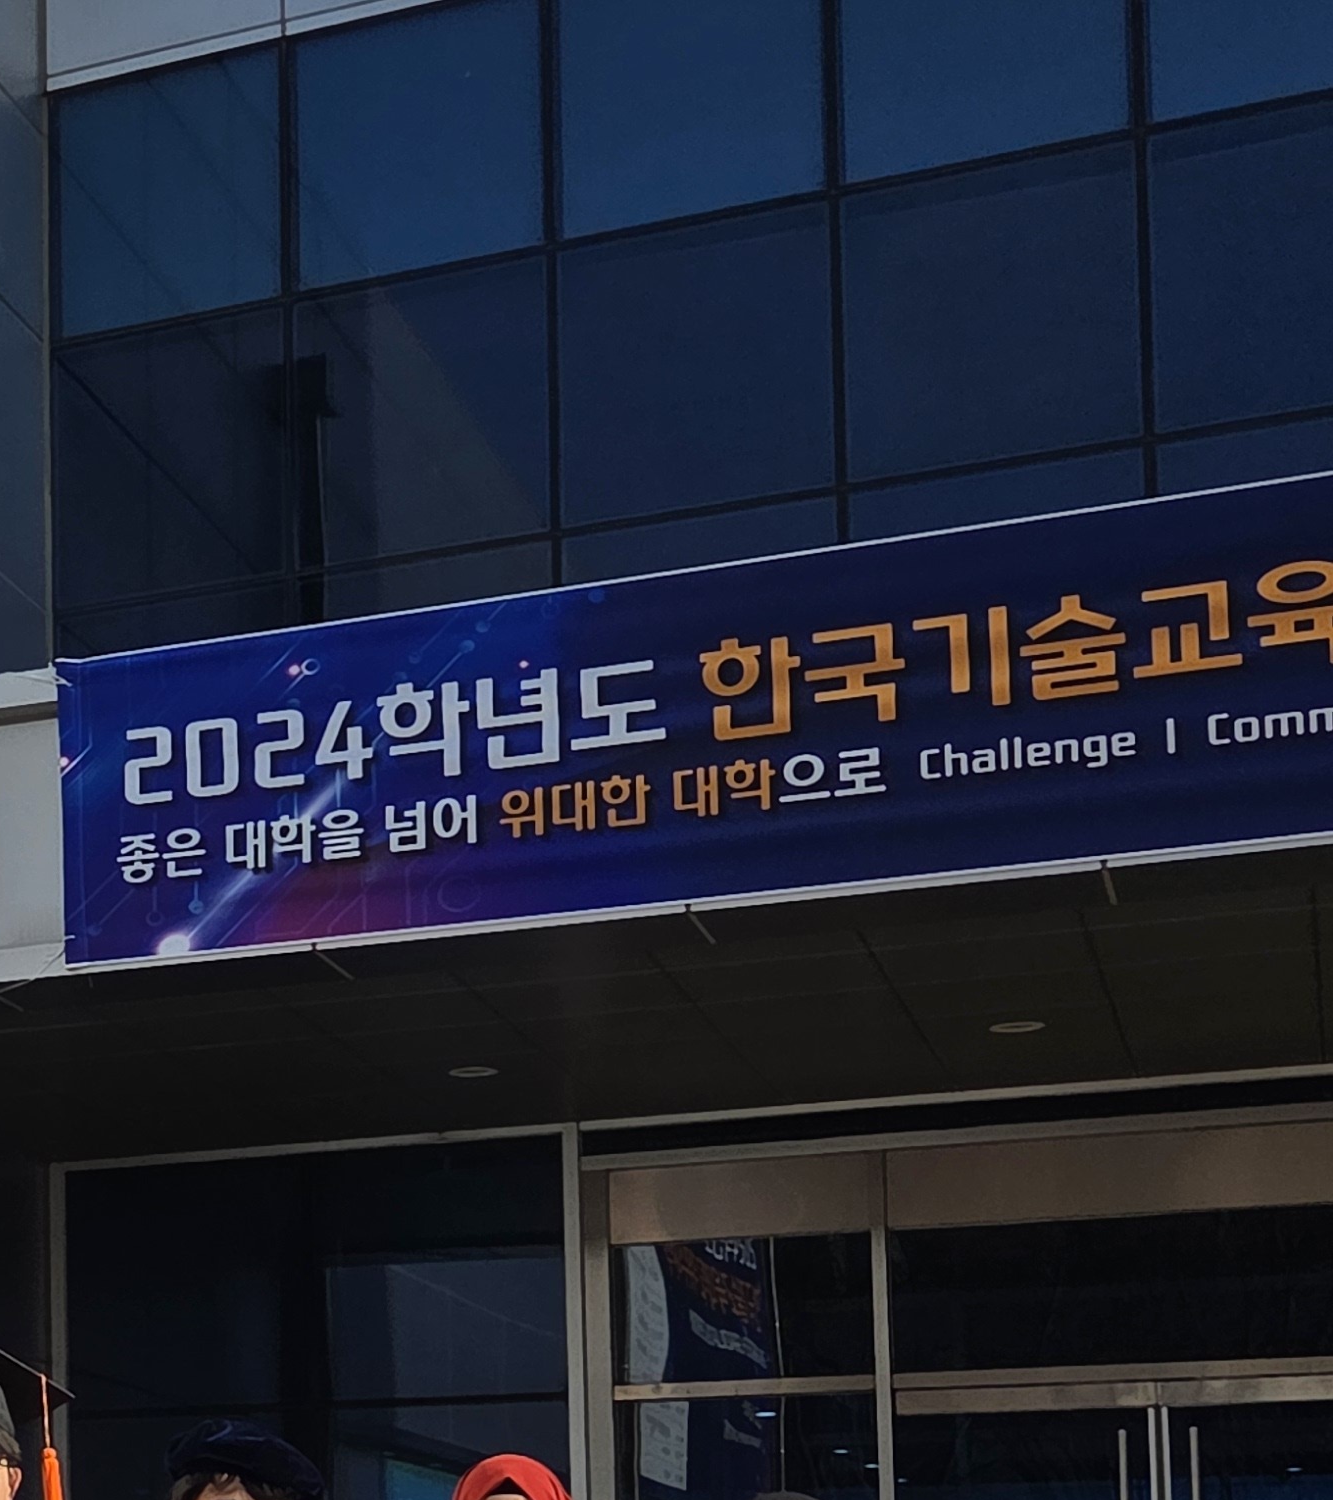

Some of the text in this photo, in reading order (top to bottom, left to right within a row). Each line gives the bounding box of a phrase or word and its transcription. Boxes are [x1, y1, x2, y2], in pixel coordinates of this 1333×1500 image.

[123, 560, 1333, 806] 2024학년도 한국기술교육
[116, 827, 207, 884] 좋은
[225, 808, 365, 870] 대학을
[384, 794, 478, 854] 넘어
[498, 774, 652, 838] 위대한
[671, 746, 888, 818] 대학으로
[919, 736, 1137, 781] Challenge
